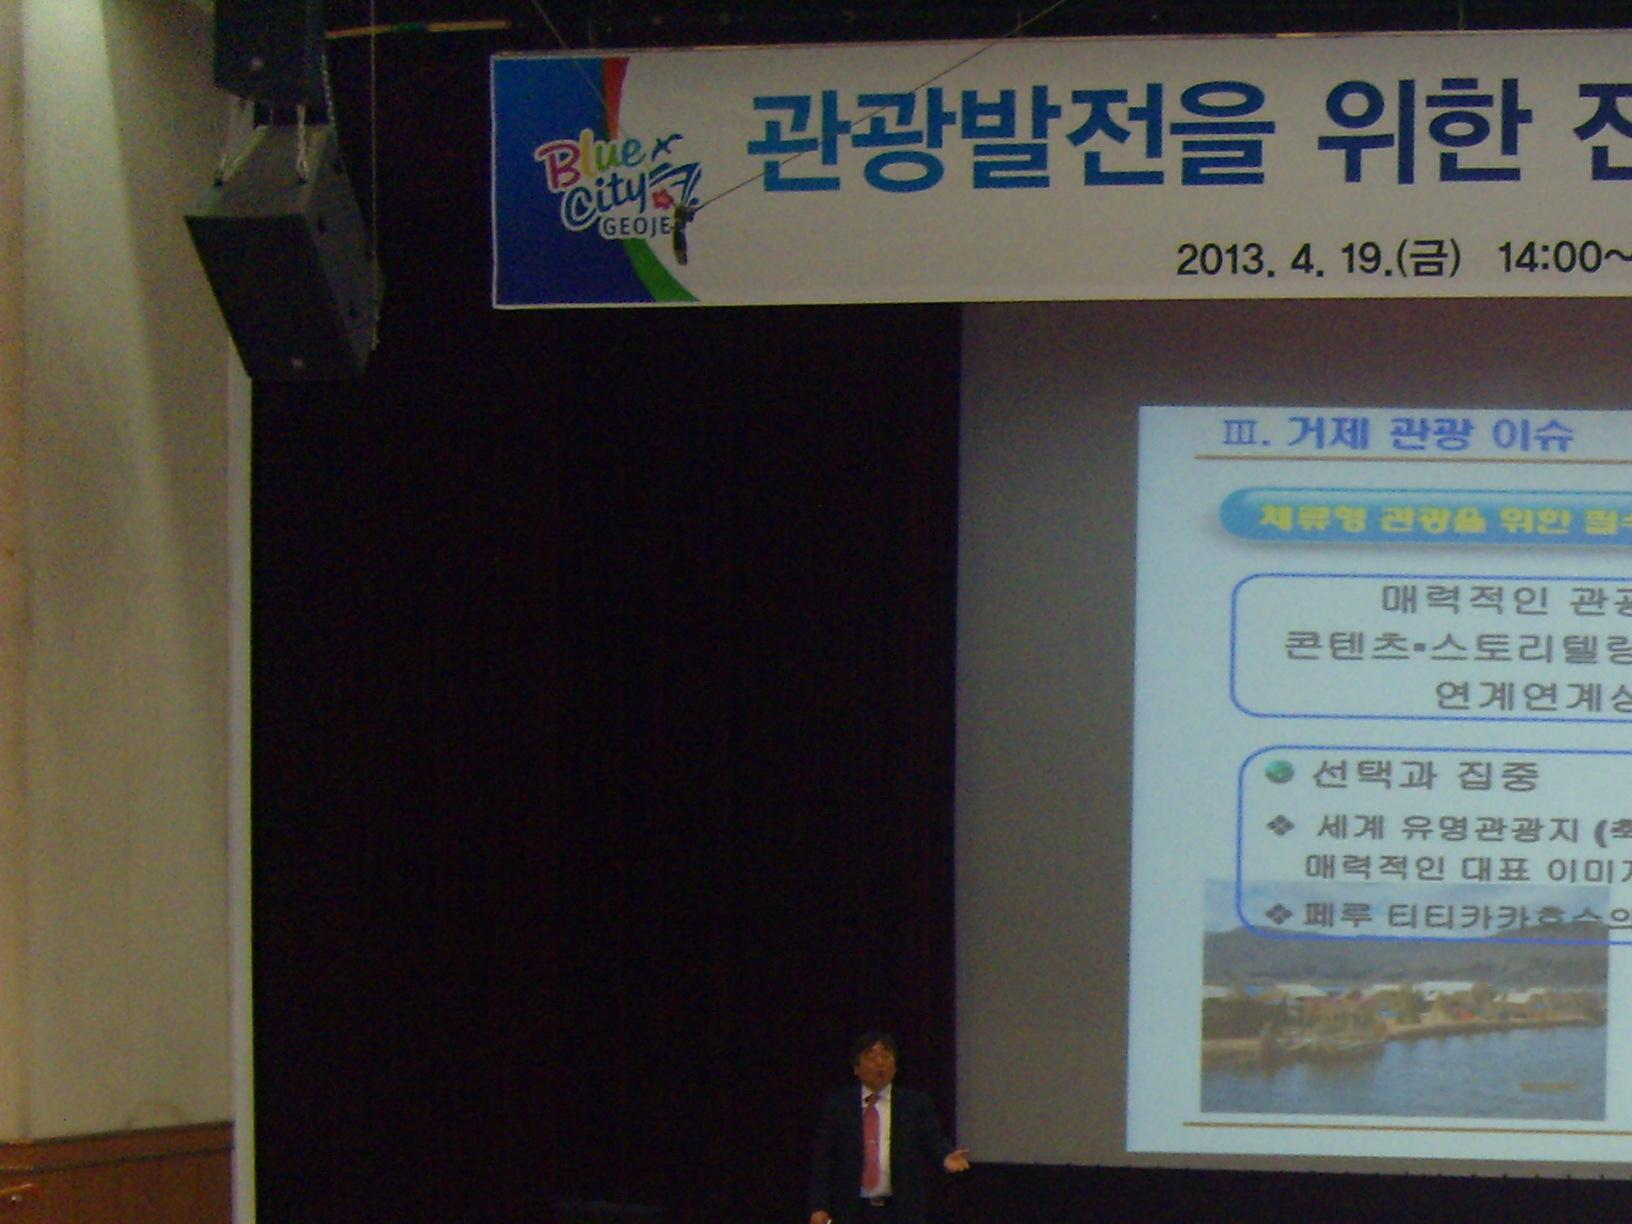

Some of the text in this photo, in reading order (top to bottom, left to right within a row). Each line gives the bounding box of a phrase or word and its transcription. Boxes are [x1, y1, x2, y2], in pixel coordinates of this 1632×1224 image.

[747, 80, 1276, 193] 관광발전을
[1317, 77, 1534, 185] 위한
[536, 129, 647, 190] Blue
[563, 172, 647, 228] City
[603, 217, 671, 237] GEOJE
[1177, 241, 1275, 276] 2013.
[1290, 243, 1325, 277] 4.
[1286, 415, 1370, 450] 거제
[1390, 416, 1474, 451] 관광
[1492, 416, 1575, 453] 이슈
[1258, 504, 1368, 533] 체류형
[1501, 506, 1573, 536] 위한
[1381, 583, 1549, 616] 매력적인
[1313, 759, 1540, 793] 선택과 집중
[1316, 813, 1386, 843] 세계
[1401, 813, 1580, 846] 유명관광지
[1304, 852, 1445, 883] 매력적인
[1460, 854, 1532, 885] 대표
[1303, 901, 1373, 929] 페루
